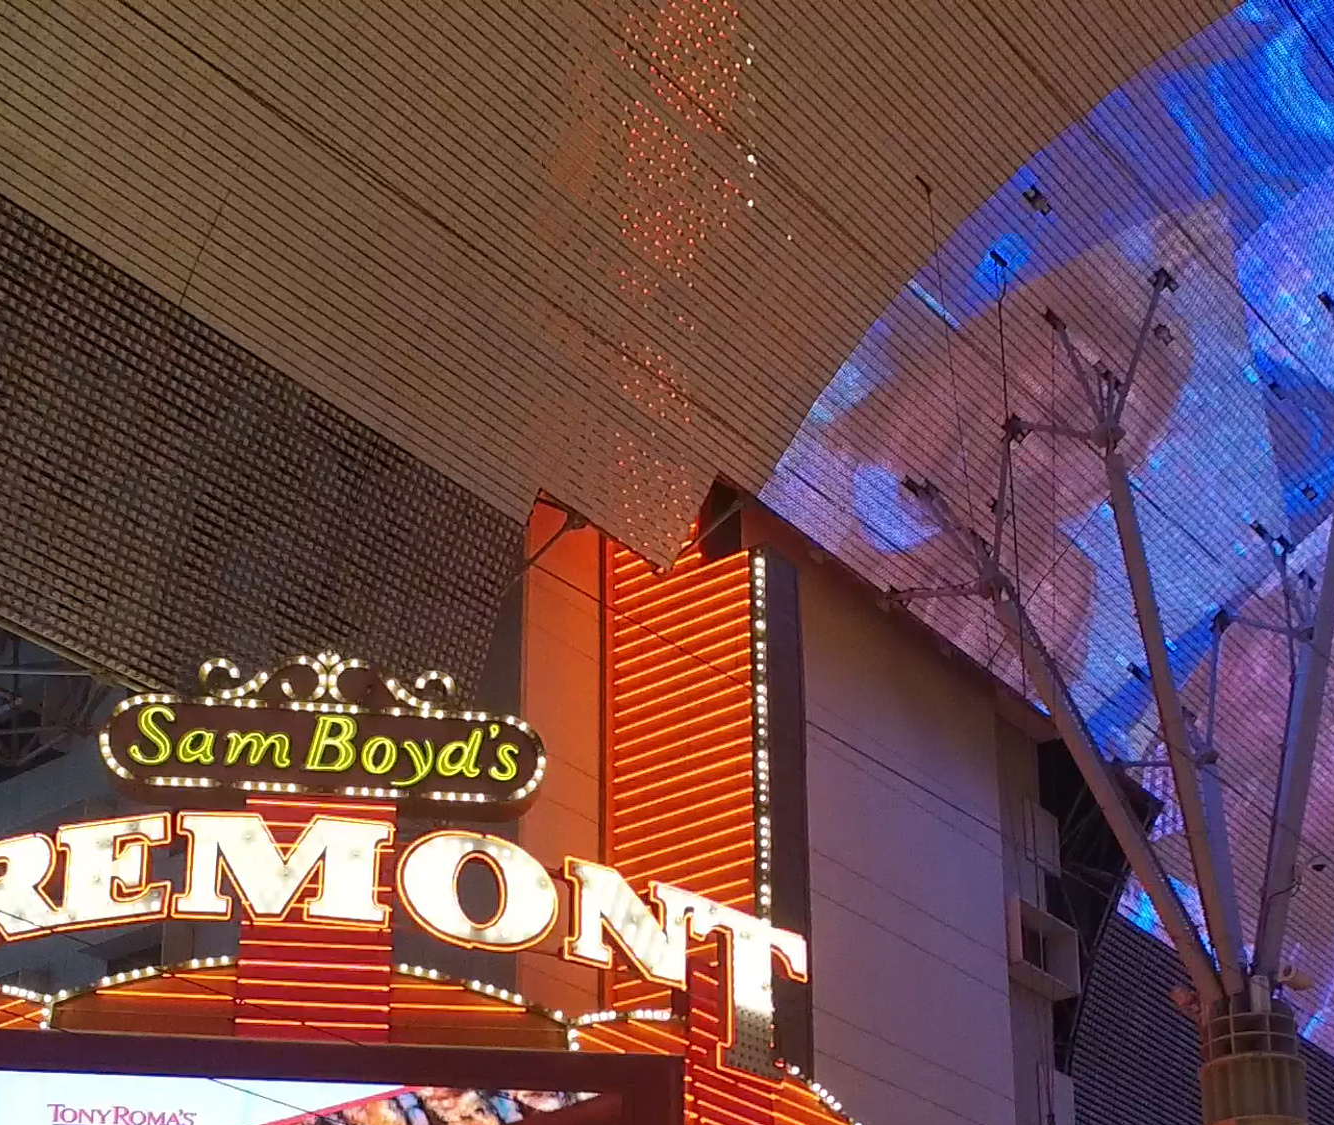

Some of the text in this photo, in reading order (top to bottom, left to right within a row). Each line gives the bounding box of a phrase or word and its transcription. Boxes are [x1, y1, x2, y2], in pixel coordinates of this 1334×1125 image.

[129, 704, 521, 788] Sam Boyd's
[47, 1103, 112, 1125] TONY
